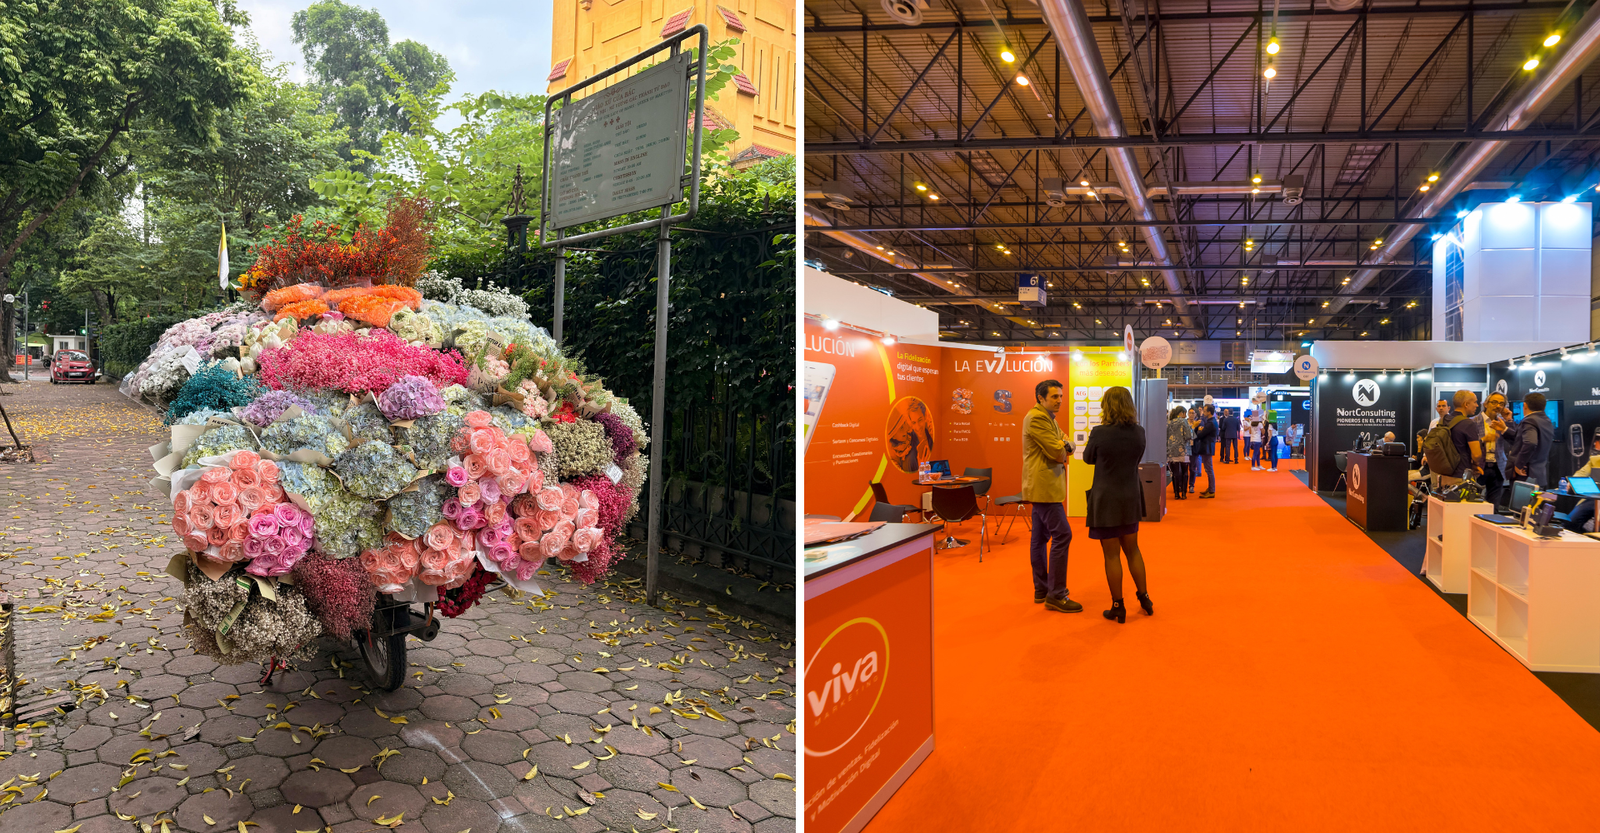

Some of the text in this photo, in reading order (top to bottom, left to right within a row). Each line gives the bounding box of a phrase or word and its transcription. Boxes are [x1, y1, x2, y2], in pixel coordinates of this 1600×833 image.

[904, 353, 931, 364] Fidelización
[897, 362, 912, 372] digital
[955, 360, 970, 372] LA
[906, 374, 924, 383] clientes
[1337, 408, 1395, 418] NortConsulting
[808, 651, 877, 717] viva
[814, 675, 878, 726] MARKETING
[826, 777, 836, 790] de
[864, 719, 899, 754] Fidelización
[817, 770, 859, 814] Motivación
[860, 747, 880, 773] Digital
